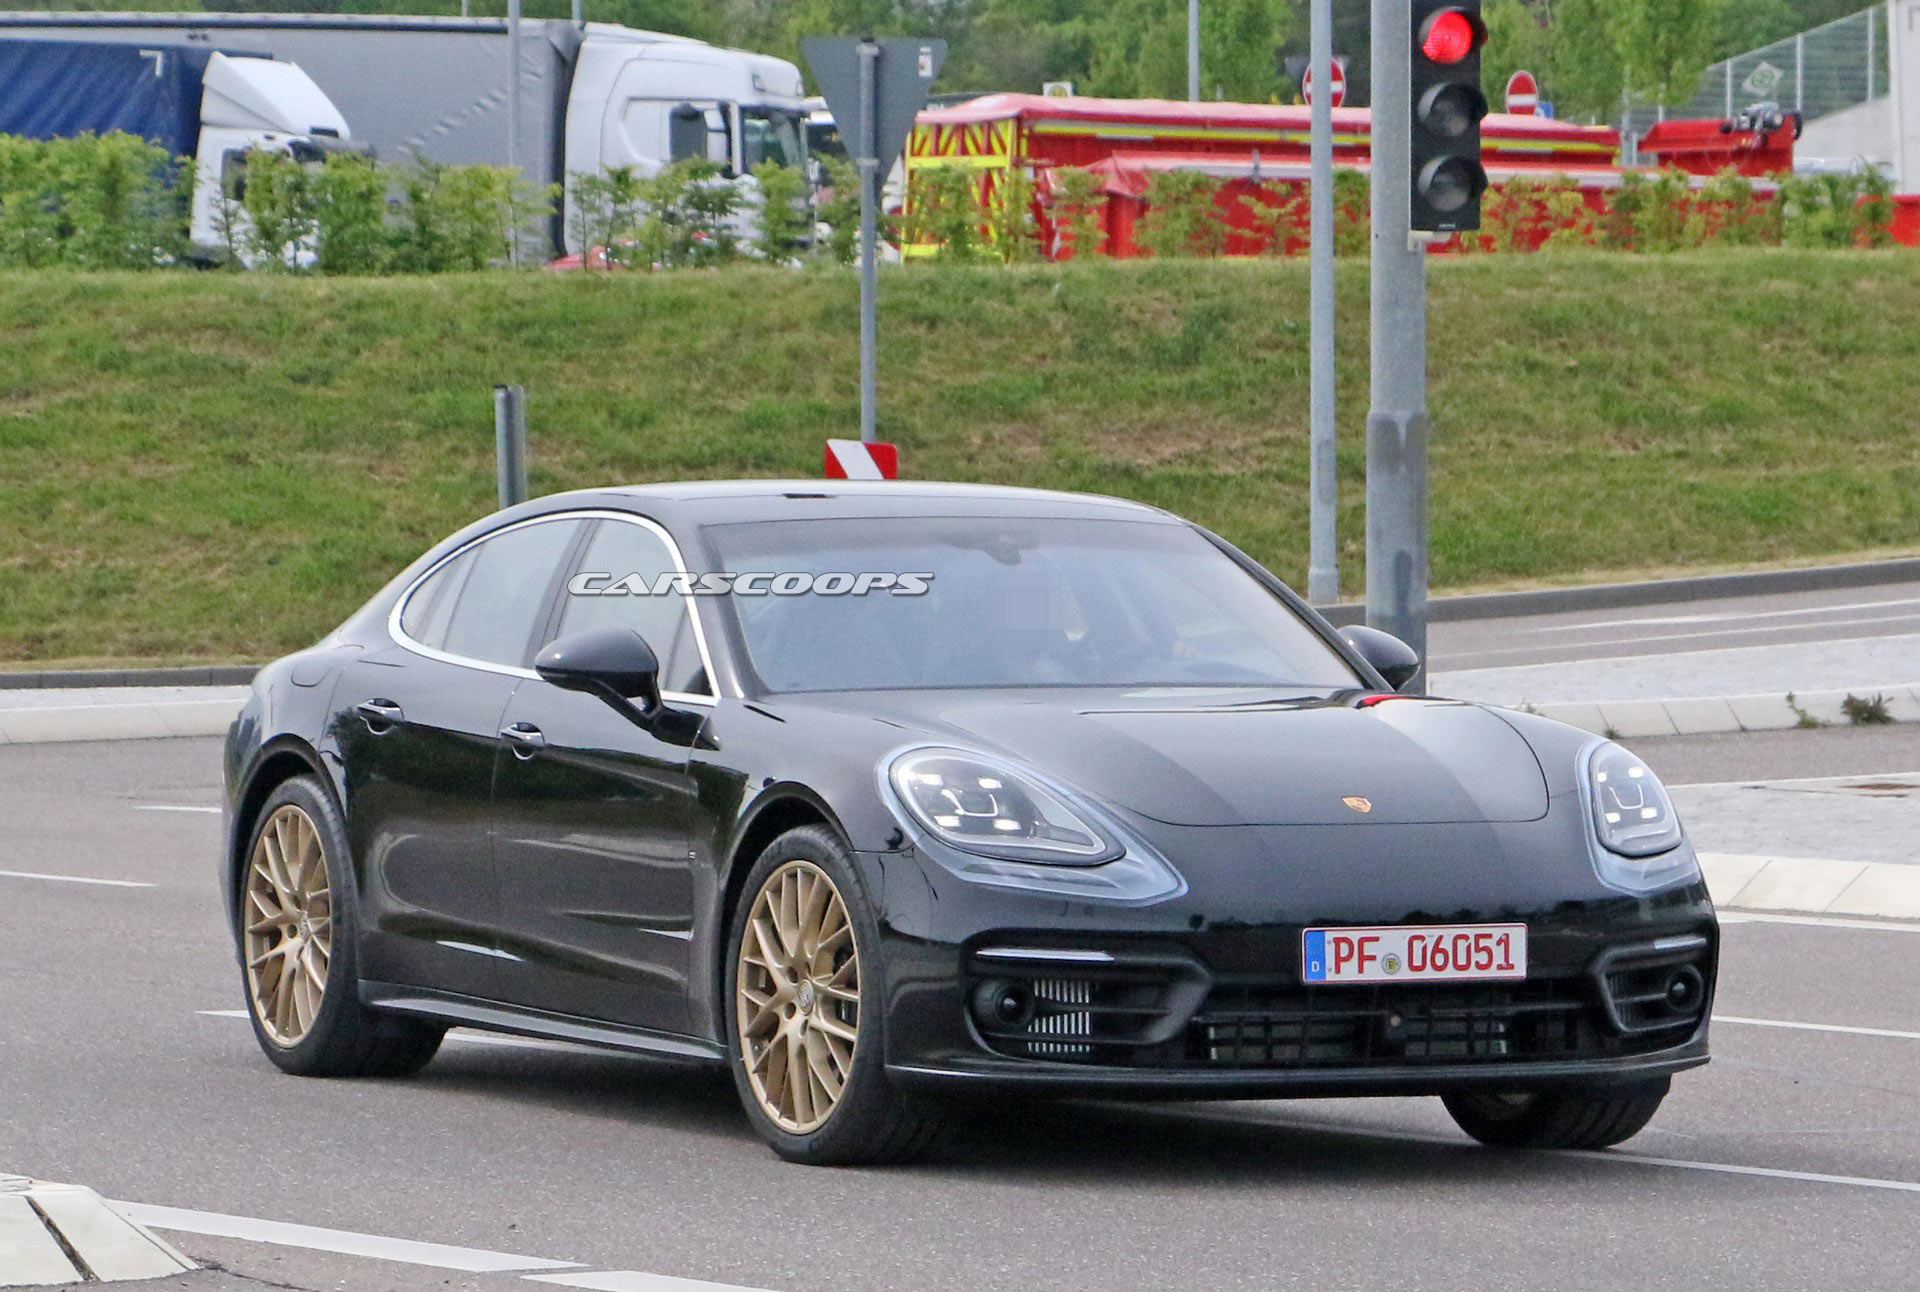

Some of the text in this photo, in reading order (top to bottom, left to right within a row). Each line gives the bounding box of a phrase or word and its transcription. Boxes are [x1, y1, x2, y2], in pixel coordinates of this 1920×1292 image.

[1311, 933, 1515, 974] D PF 06051
